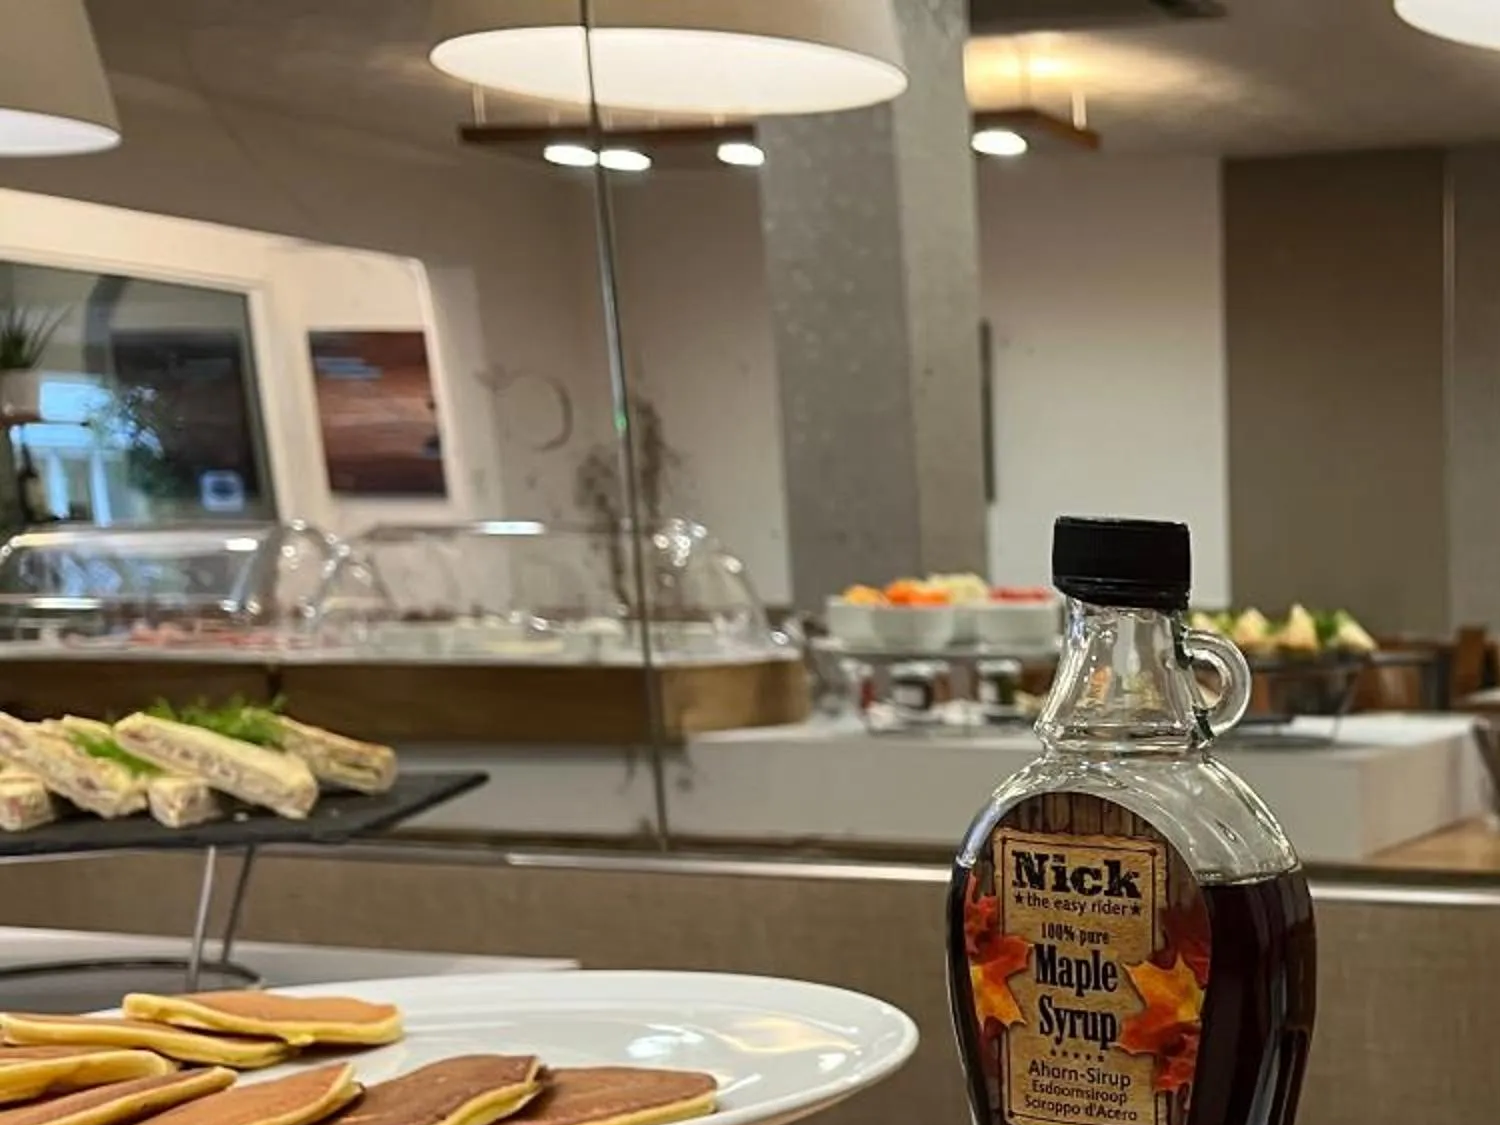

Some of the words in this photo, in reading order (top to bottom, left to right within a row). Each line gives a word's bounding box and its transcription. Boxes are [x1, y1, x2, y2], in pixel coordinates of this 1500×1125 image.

[1011, 850, 1142, 899] Nick
[1026, 892, 1050, 909] the
[1054, 897, 1087, 917] easy
[1091, 899, 1129, 916] rider
[1041, 921, 1076, 941] 100%
[1079, 928, 1110, 946] pure
[1035, 945, 1118, 997] Maple
[1039, 997, 1118, 1050] Syrup
[1027, 1059, 1131, 1088] Ahorn-Sirup
[1024, 1093, 1081, 1117] Sciroppo
[1084, 1101, 1138, 1122] d'Acero
